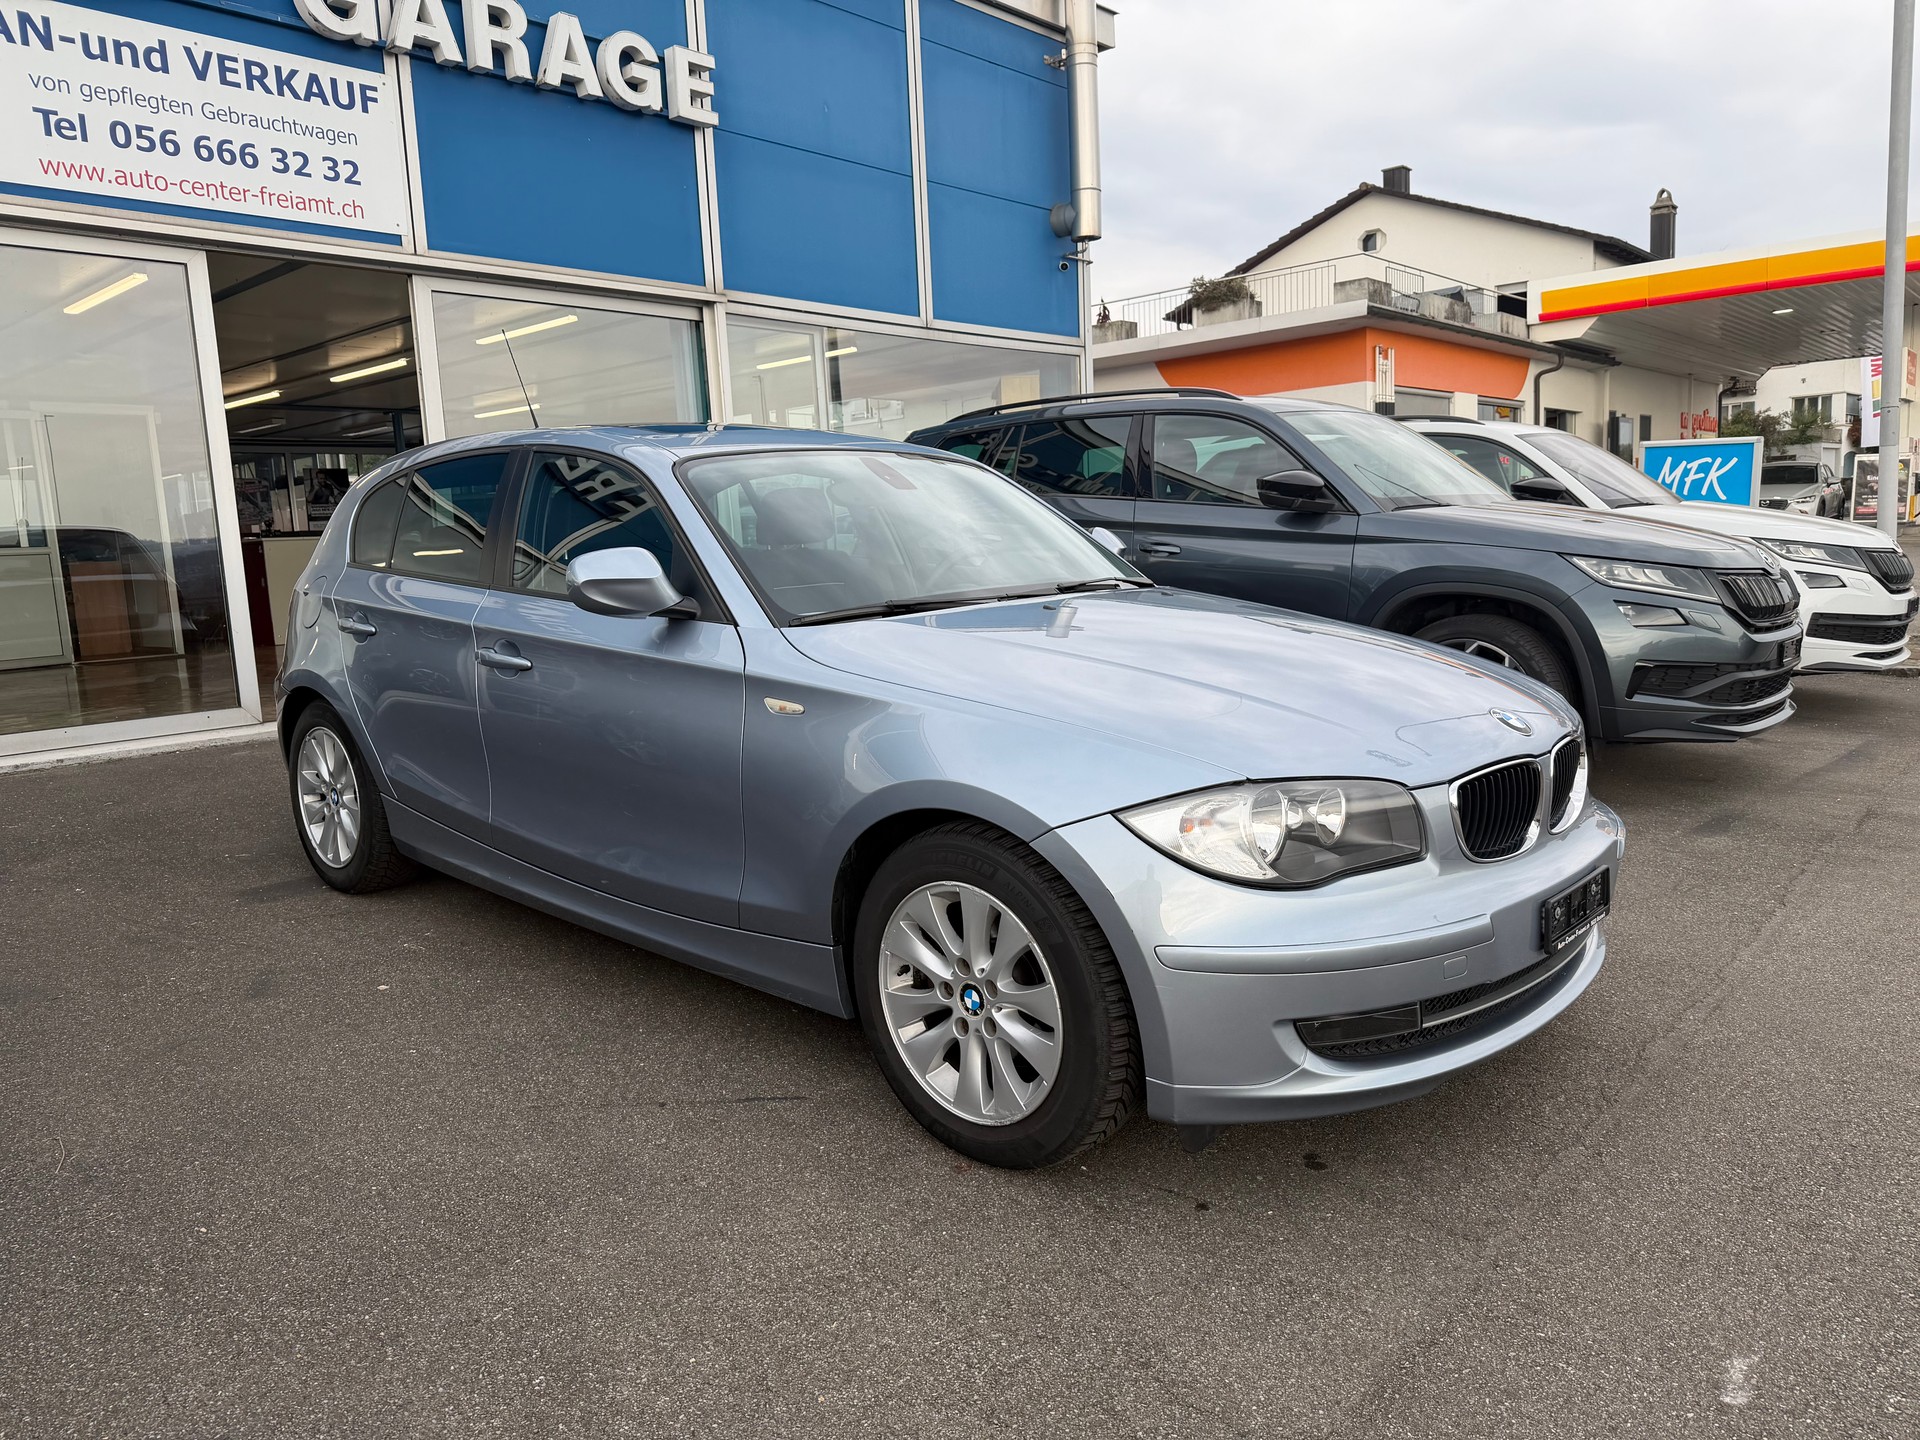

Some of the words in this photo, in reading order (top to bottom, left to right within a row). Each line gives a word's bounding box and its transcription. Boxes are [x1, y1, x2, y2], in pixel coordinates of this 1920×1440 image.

[28, 72, 71, 95] von
[79, 80, 194, 117] gepflegten
[200, 101, 359, 146] Gebrauchtwagen
[182, 45, 379, 115] VERKAUF
[32, 106, 89, 143] Tel
[108, 119, 181, 157] 056
[193, 134, 259, 170] 666
[270, 147, 312, 178] 32
[321, 155, 363, 186] 32
[38, 157, 365, 220] www.auto-center-freiamt.ch
[1657, 456, 1738, 500] MFK
